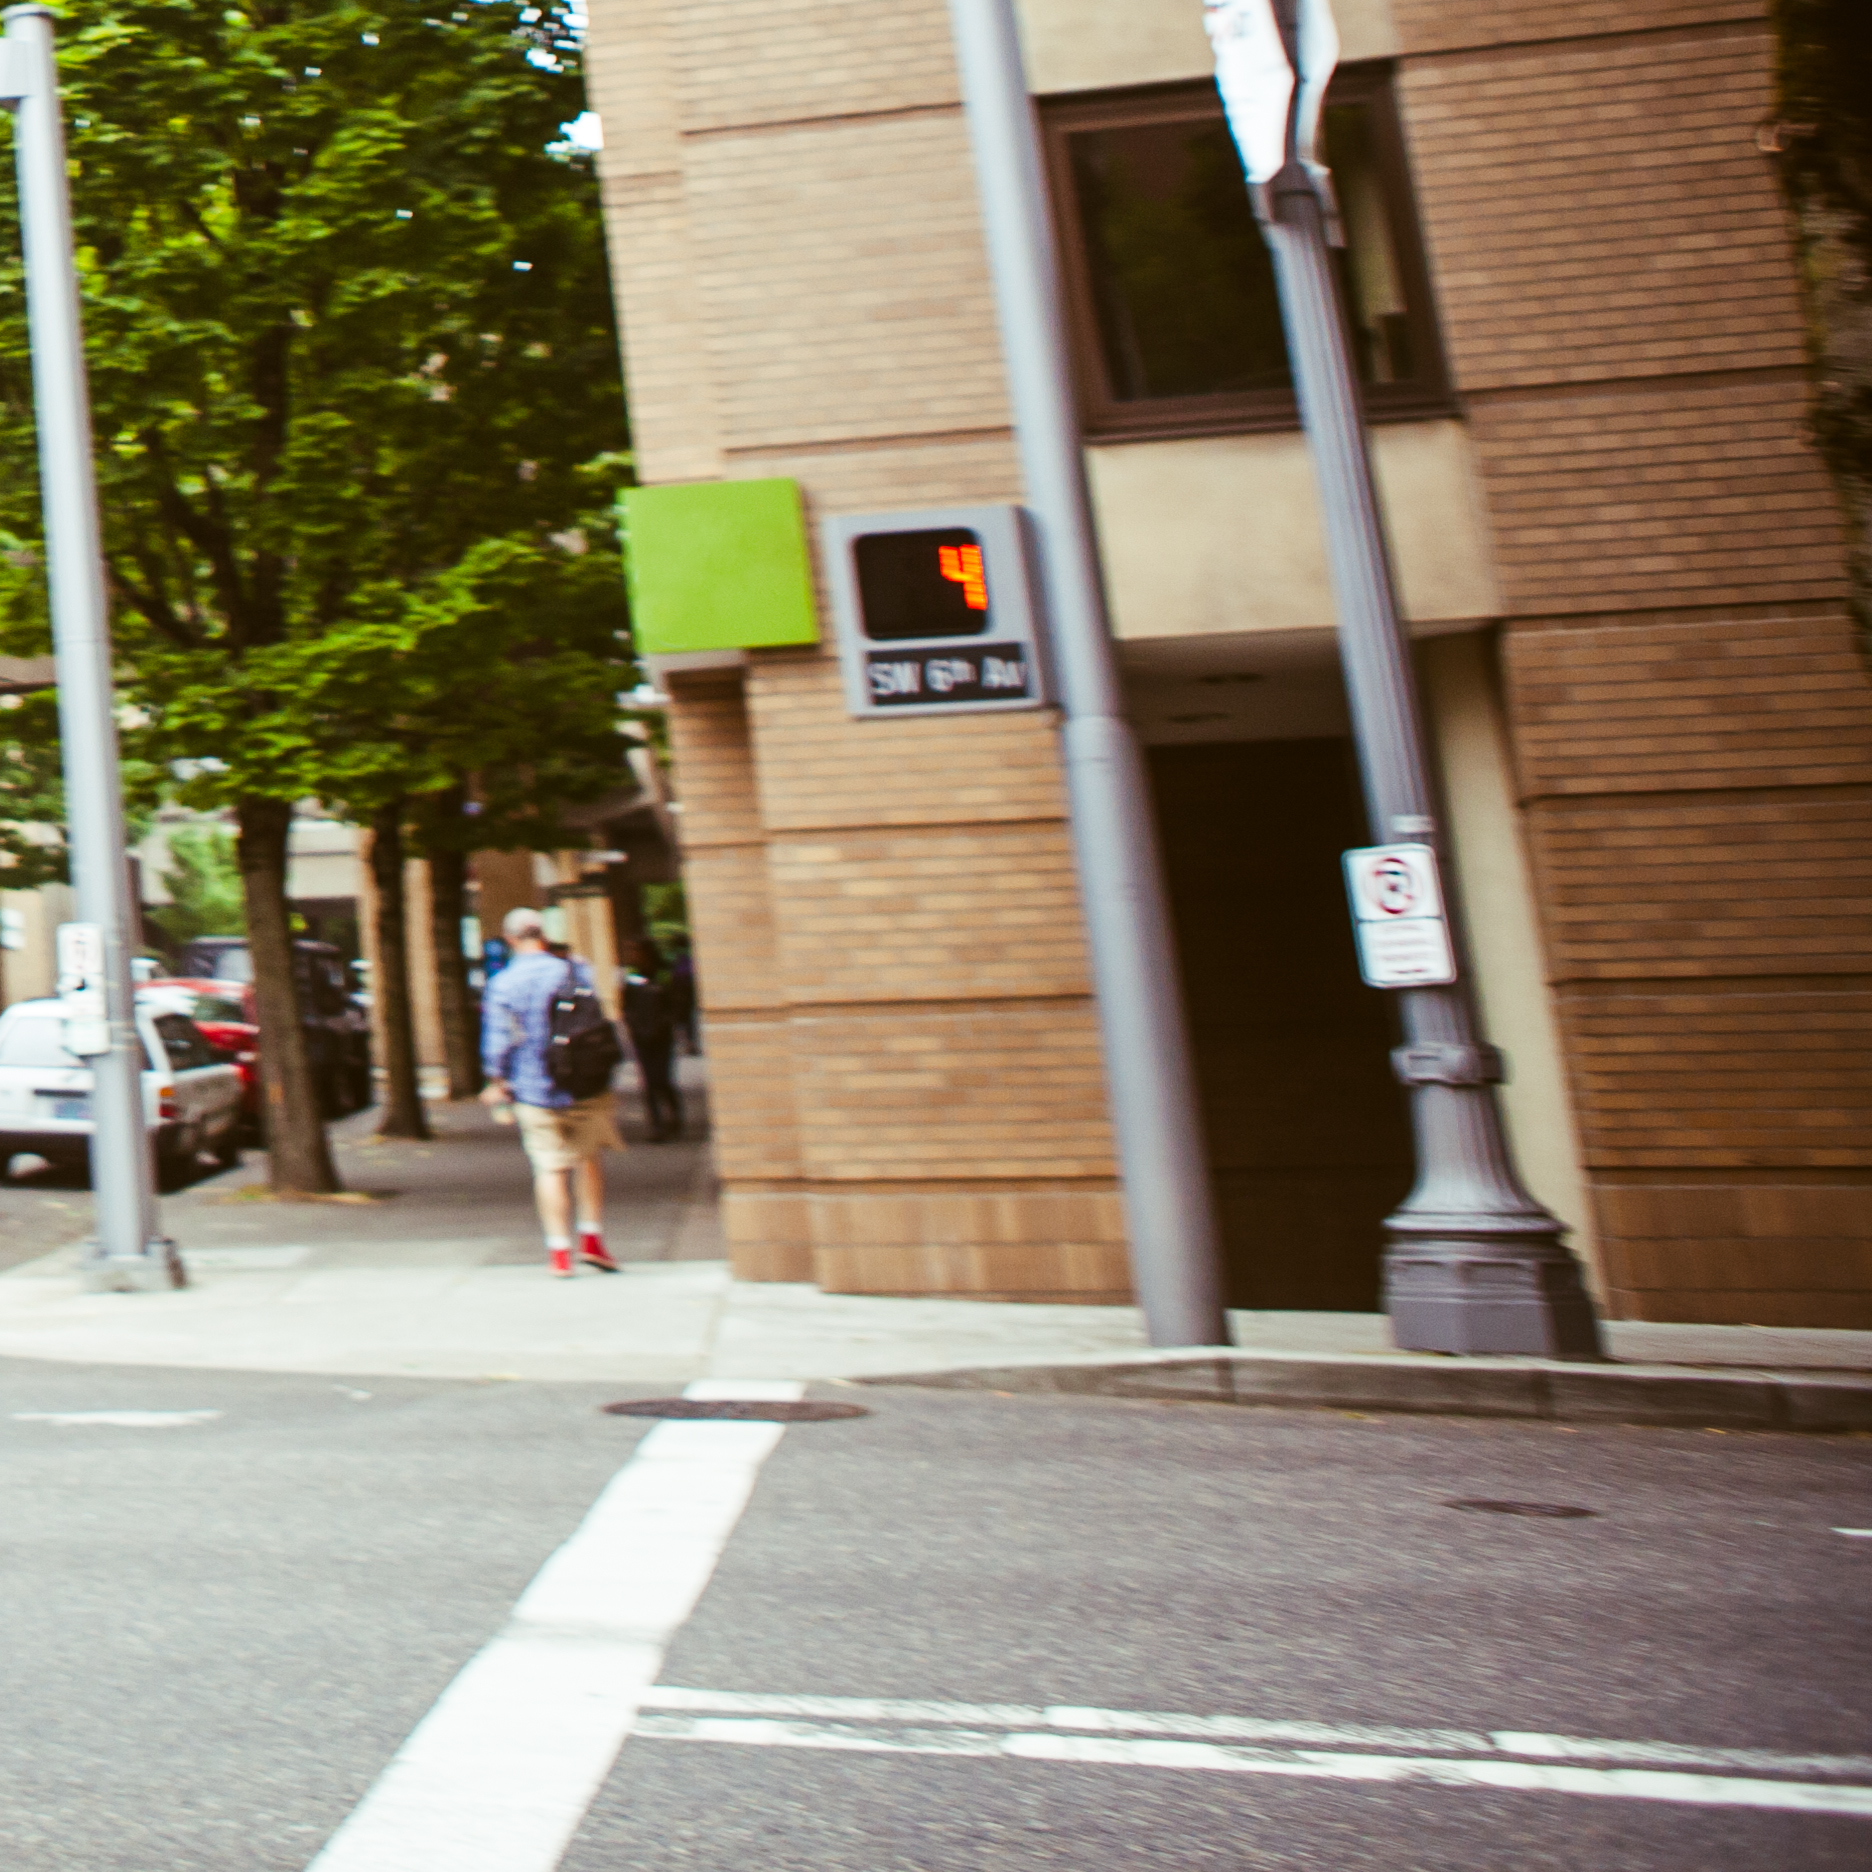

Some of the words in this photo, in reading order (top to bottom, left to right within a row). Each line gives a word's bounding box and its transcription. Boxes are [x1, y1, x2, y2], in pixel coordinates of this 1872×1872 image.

[938, 544, 988, 610] 4
[868, 662, 921, 696] SW
[925, 658, 978, 692] 6th
